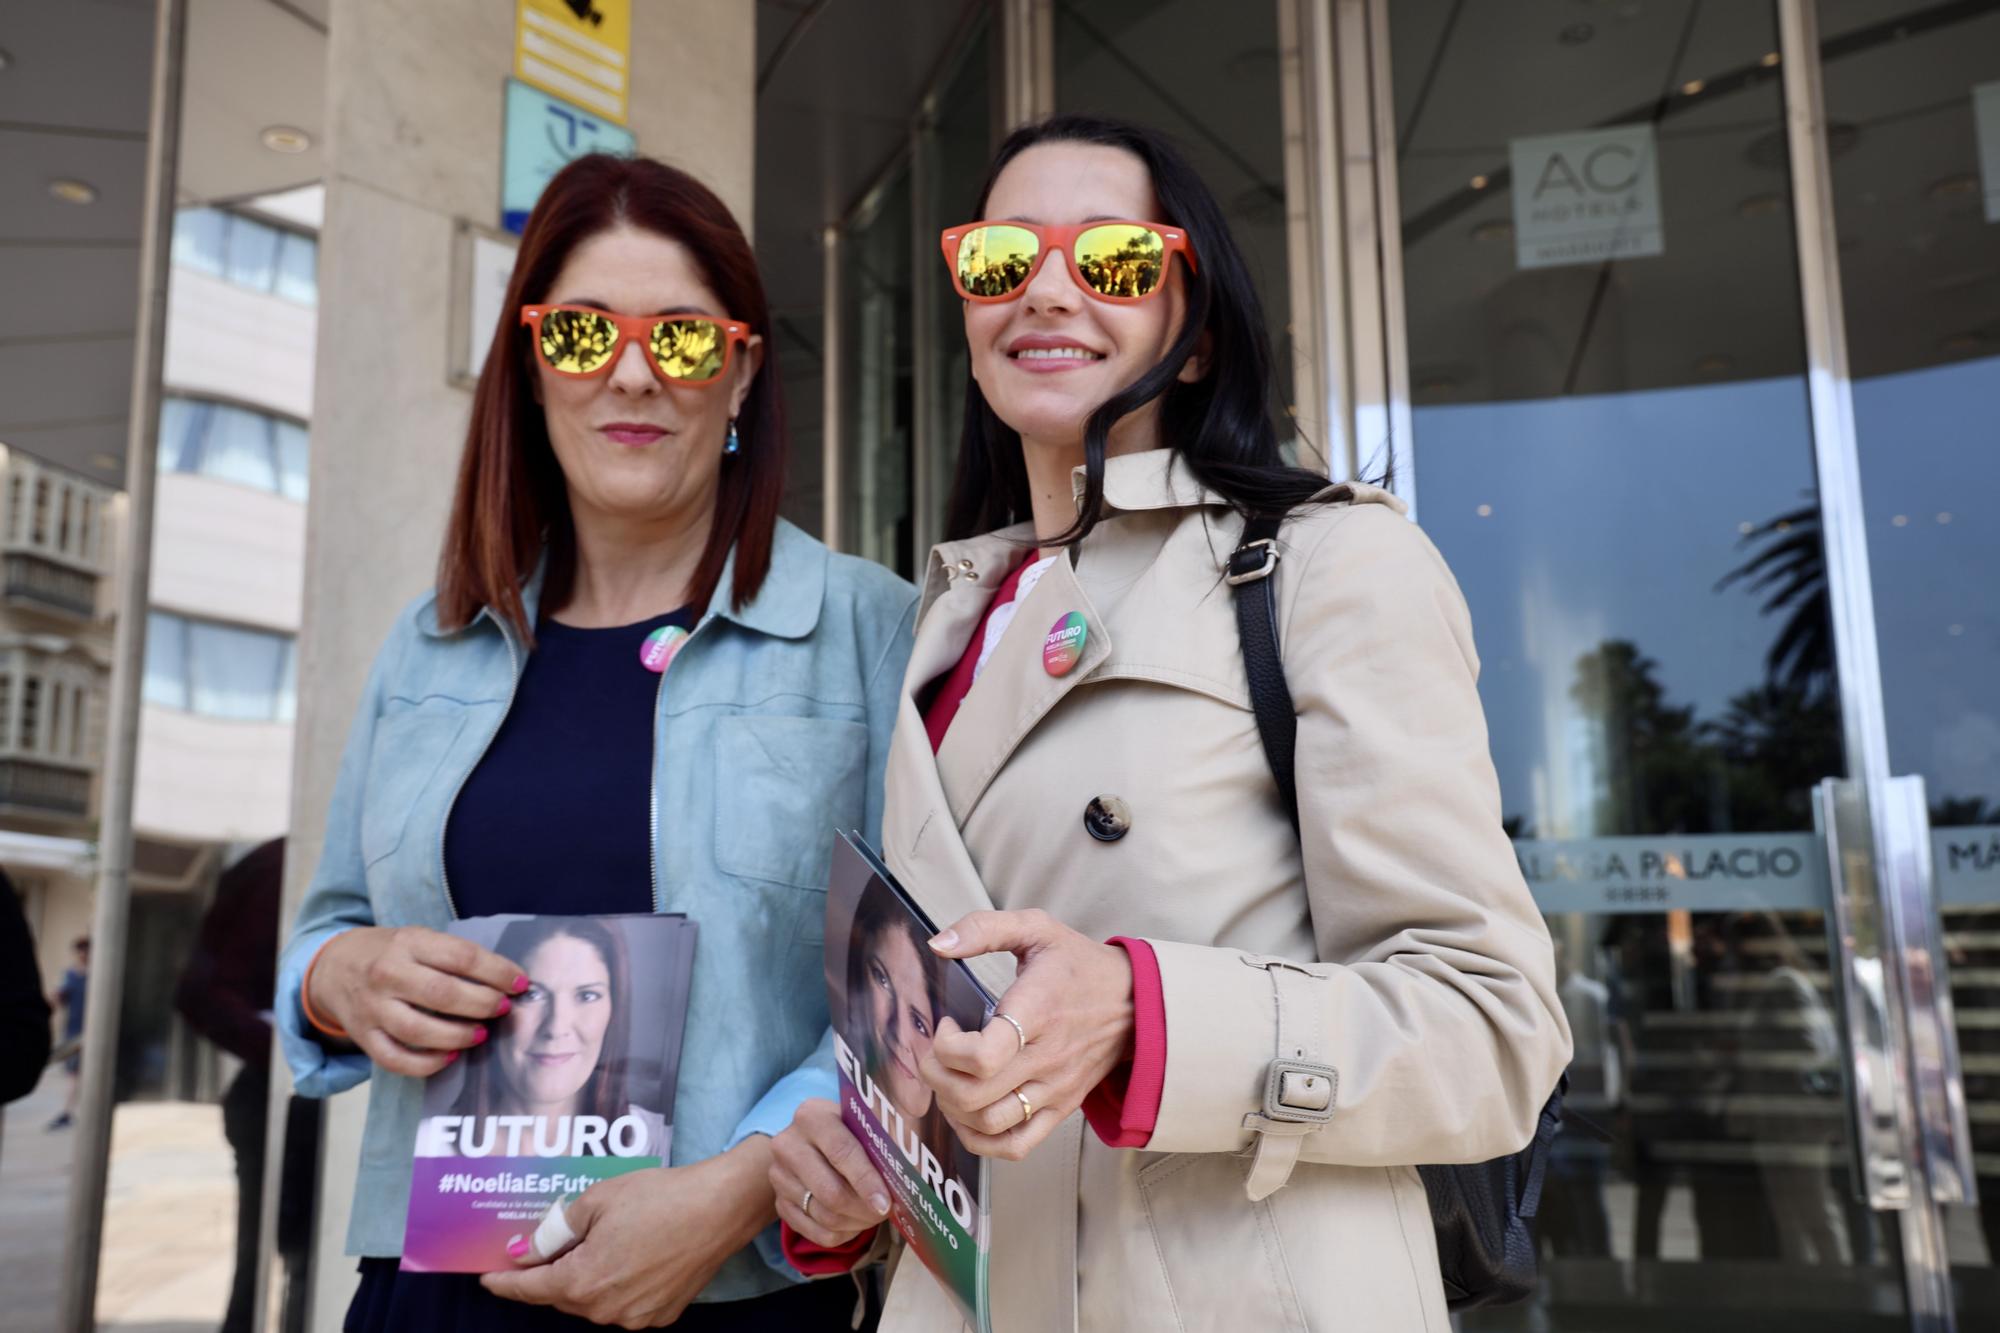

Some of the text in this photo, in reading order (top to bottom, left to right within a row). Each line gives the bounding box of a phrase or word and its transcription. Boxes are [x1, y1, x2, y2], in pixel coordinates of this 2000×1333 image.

[1532, 143, 1640, 202] AC
[1047, 625, 1082, 645] FUTURO
[1640, 847, 1803, 881] PALACIO
[428, 1114, 649, 1158] FUTURO
[834, 1031, 972, 1230] FUTURO
[439, 1172, 602, 1193] #NoeliaEsFut
[850, 1097, 958, 1250] #NoeliaEsFuturo
